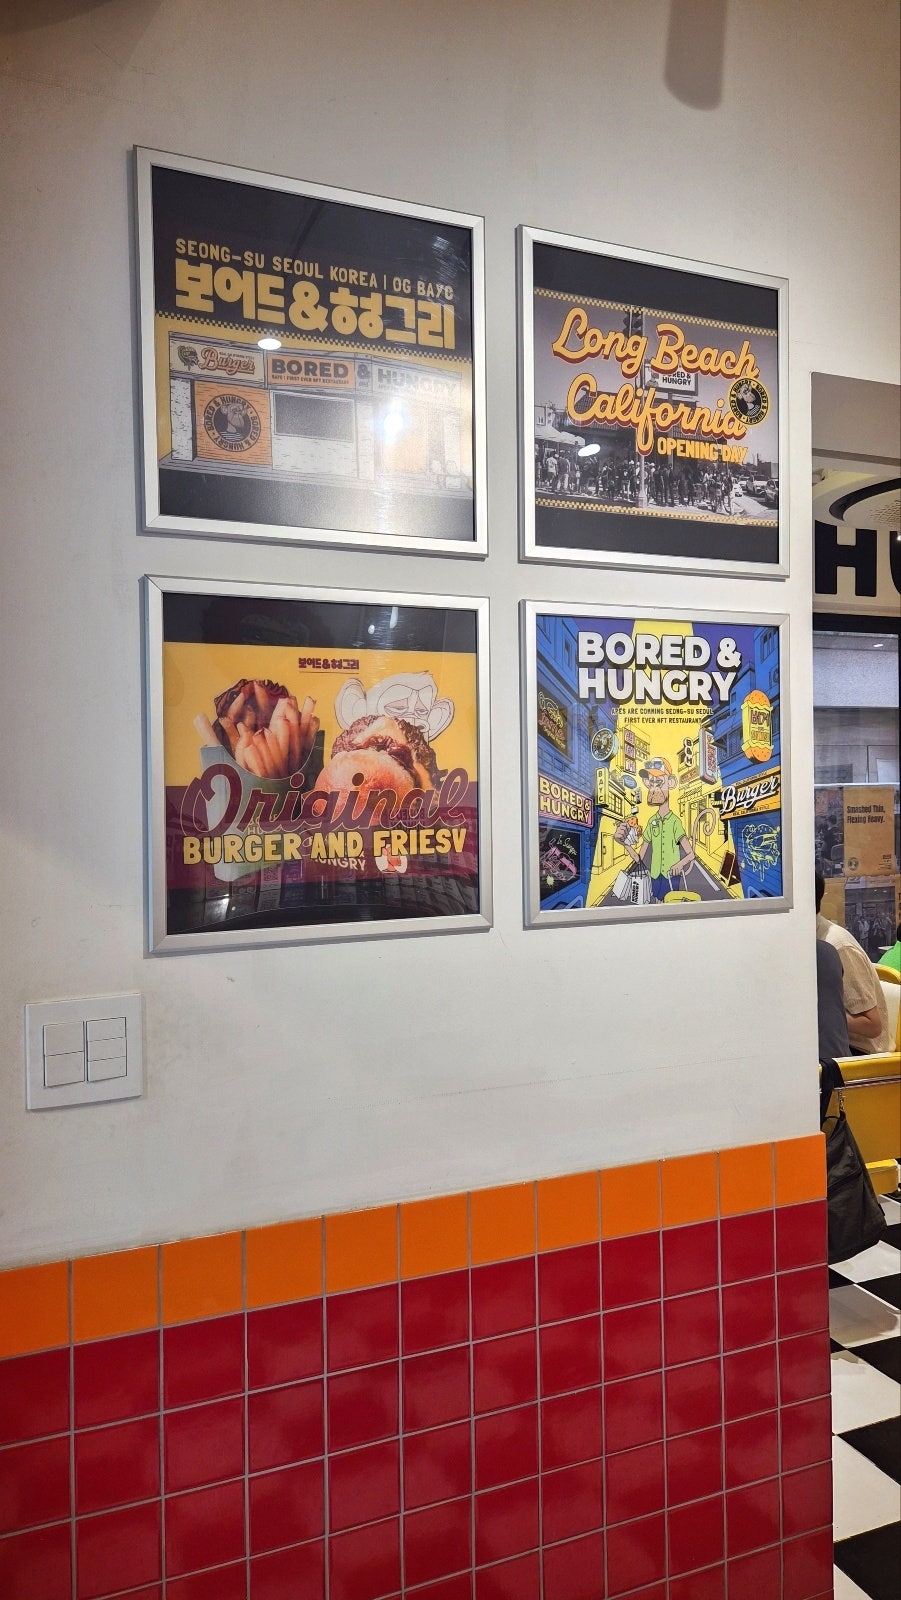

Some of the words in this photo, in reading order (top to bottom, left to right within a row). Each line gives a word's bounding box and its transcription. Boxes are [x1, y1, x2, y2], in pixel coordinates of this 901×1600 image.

[176, 238, 265, 269] SEONG-SU
[272, 256, 323, 279] SEOUL
[330, 265, 378, 289] KOREA
[392, 277, 412, 294] OG
[198, 346, 256, 376] Burger
[552, 307, 648, 380] Long
[650, 323, 760, 380] Beach
[271, 359, 349, 378] BORED
[357, 363, 371, 379] &
[662, 377, 692, 386] HUNGRY
[567, 373, 748, 456] California
[657, 437, 719, 461] OPENING
[721, 443, 749, 464] DAY
[814, 519, 901, 598] H
[577, 631, 712, 670] BORED
[716, 637, 742, 672] &
[577, 668, 737, 705] HUNGRY
[180, 763, 467, 845] Original
[539, 776, 583, 809] BORED
[583, 799, 591, 811] &
[539, 794, 590, 824] HUNGRY
[719, 775, 779, 815] Burger
[847, 805, 872, 814] Smashed
[847, 815, 867, 825] Flexing
[182, 832, 303, 866] BURGER
[310, 831, 364, 859] AND
[372, 827, 467, 858] FRIESV
